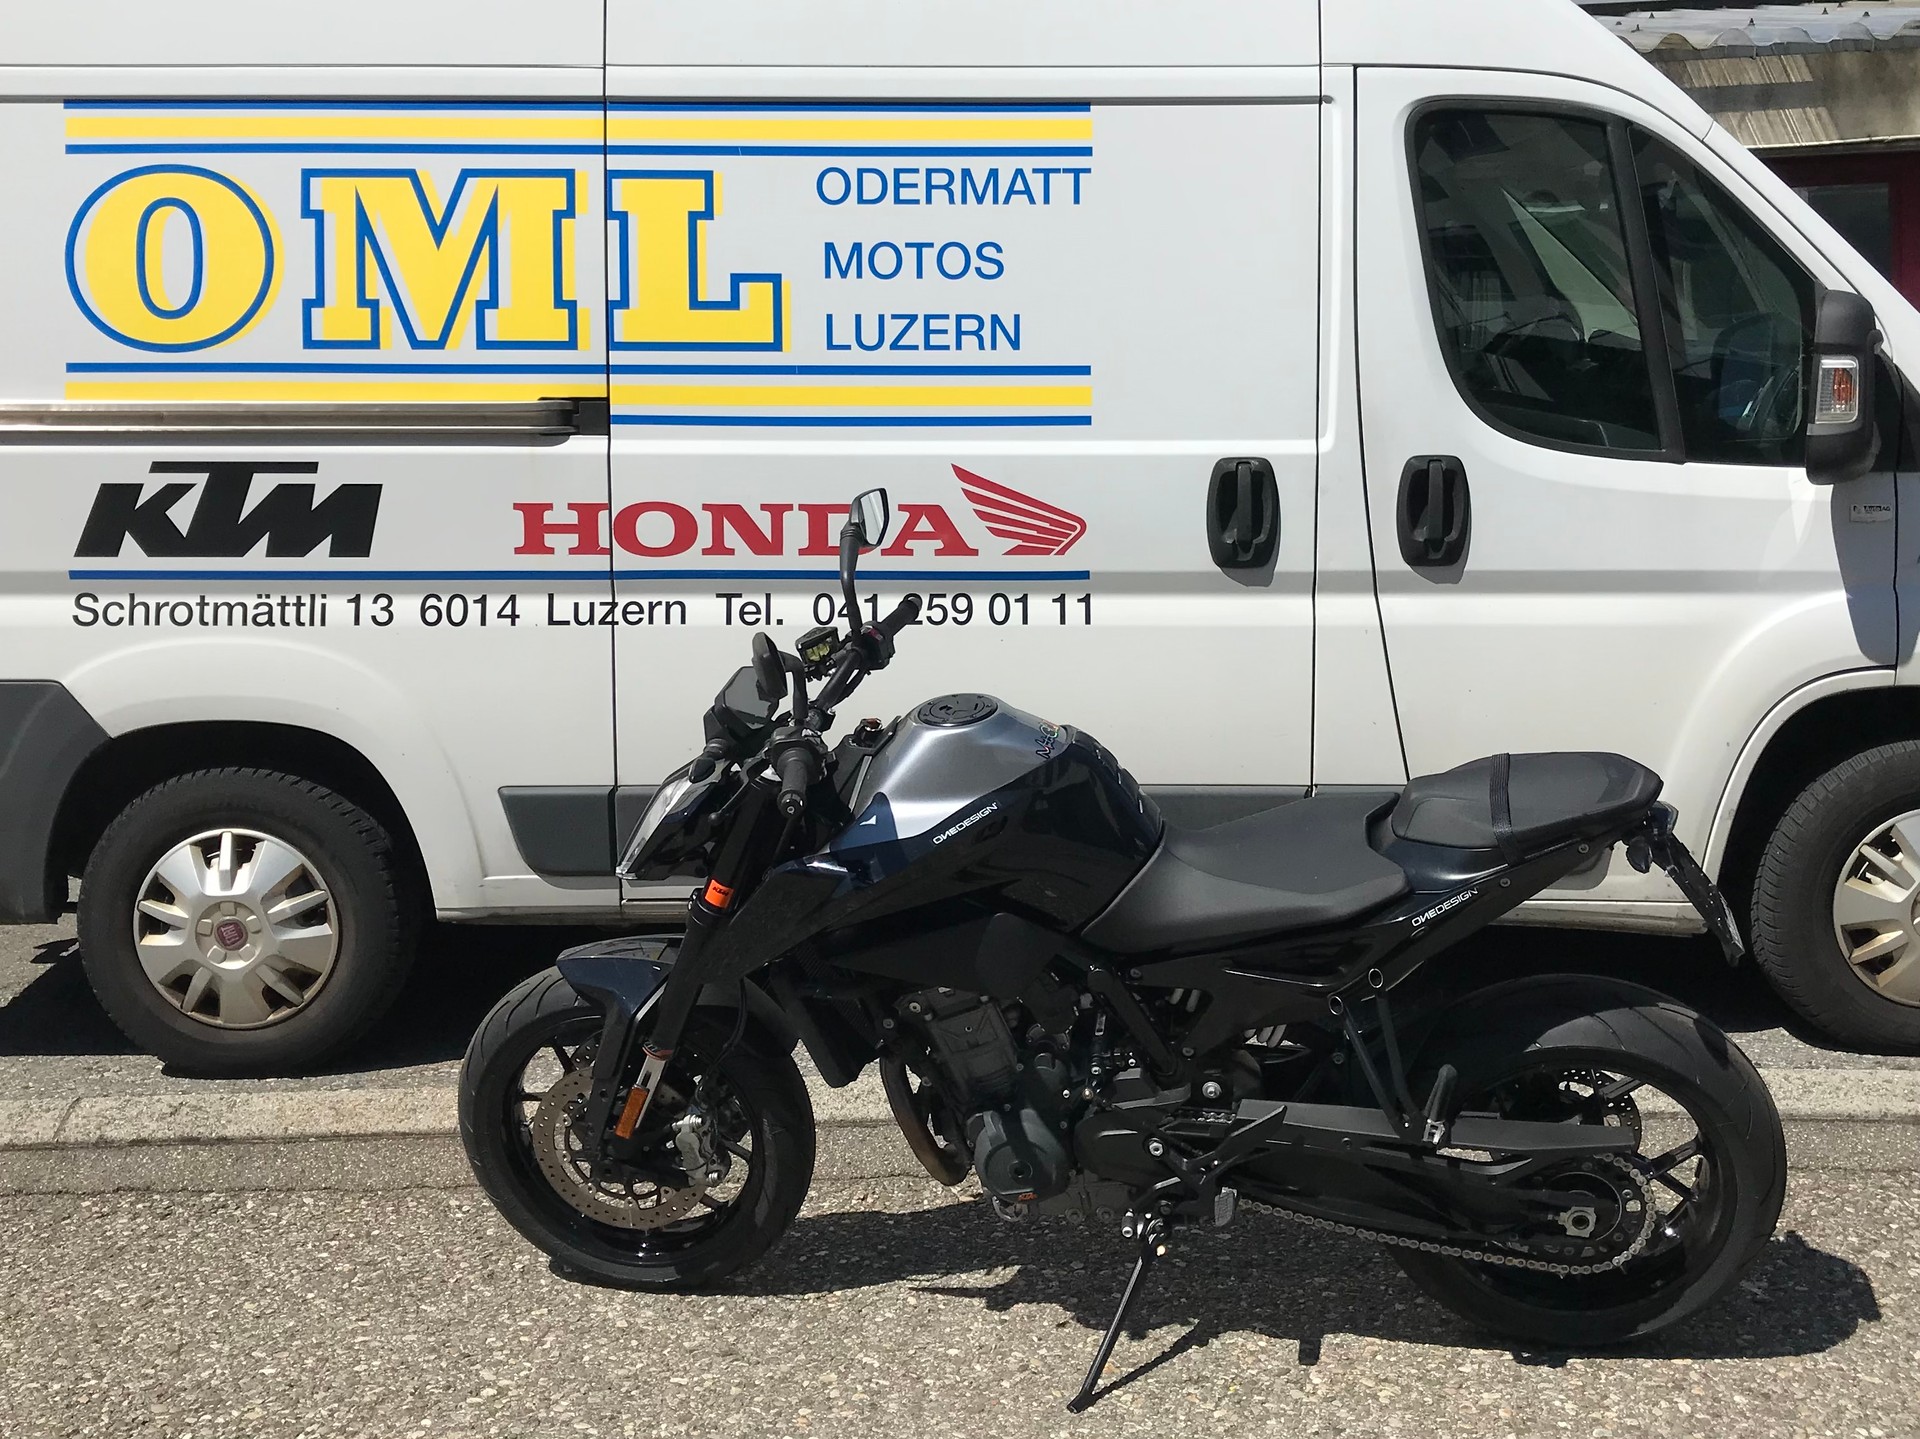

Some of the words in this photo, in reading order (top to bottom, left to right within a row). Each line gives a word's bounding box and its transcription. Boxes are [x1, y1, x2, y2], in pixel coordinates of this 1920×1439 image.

[816, 167, 1092, 205] ODERMATT
[65, 163, 791, 353] OML
[824, 242, 1004, 280] MOTOS
[826, 314, 1021, 351] LUZERN
[74, 461, 383, 558] KTM
[513, 501, 979, 557] HONDA
[72, 593, 328, 627] Schrotmättli
[347, 593, 395, 627] 13
[419, 593, 520, 627] 6014
[547, 593, 687, 627] Luzern
[715, 593, 784, 626] Tel.
[988, 592, 1029, 626] 01
[1052, 592, 1092, 626] 11
[932, 802, 998, 845] ONEDESIGN
[1411, 887, 1479, 927] ONEDESIGN
